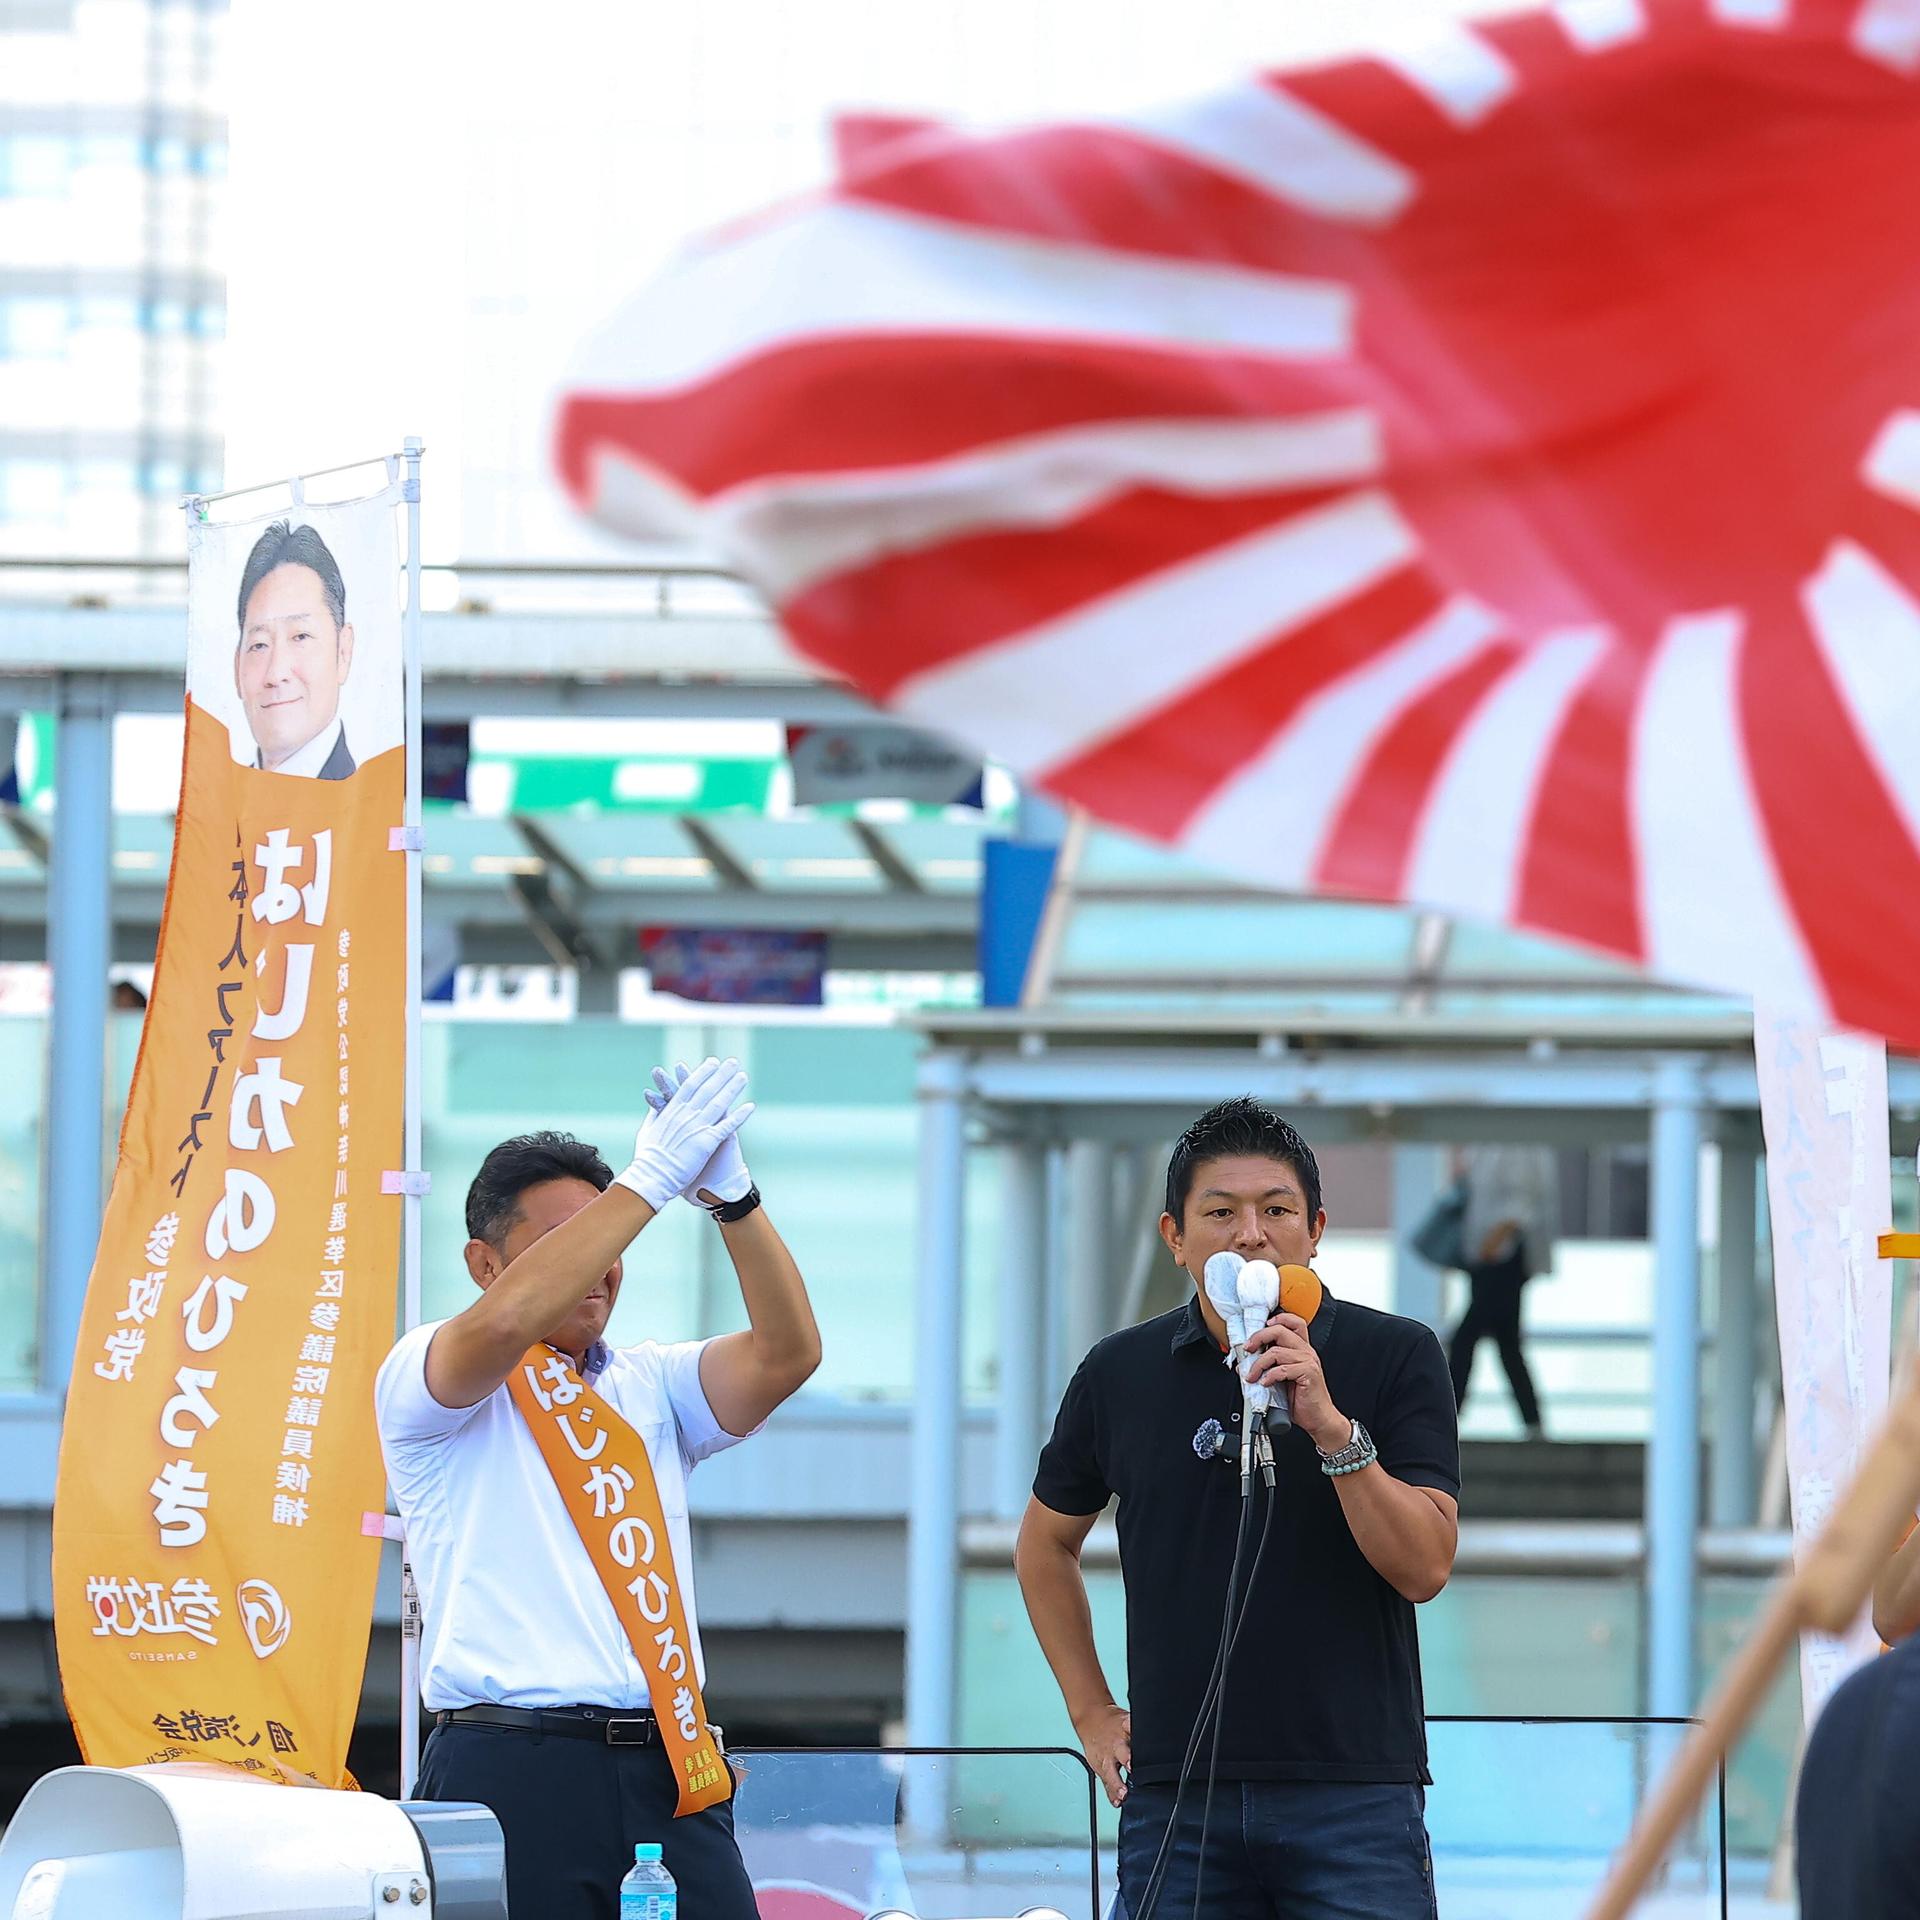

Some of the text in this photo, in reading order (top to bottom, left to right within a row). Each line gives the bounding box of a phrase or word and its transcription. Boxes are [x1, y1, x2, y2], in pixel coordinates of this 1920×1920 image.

[523, 1356, 699, 1742] はじかのひろき
